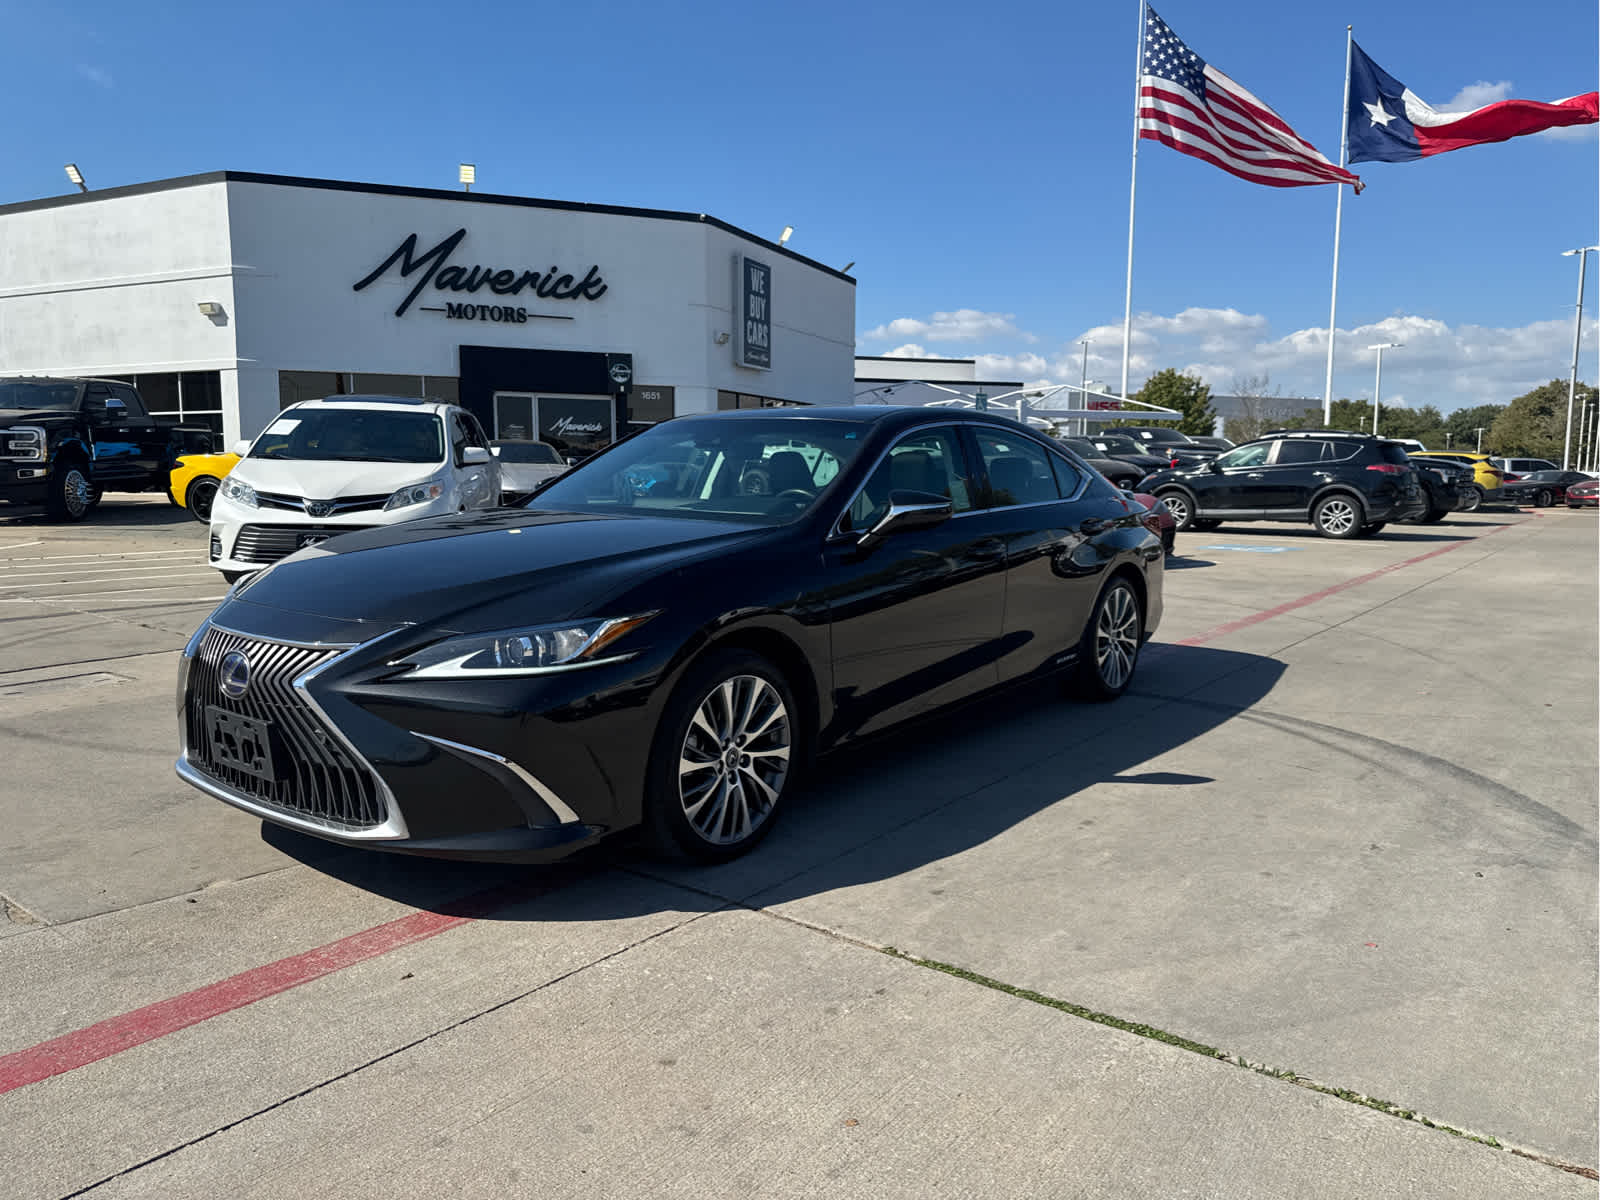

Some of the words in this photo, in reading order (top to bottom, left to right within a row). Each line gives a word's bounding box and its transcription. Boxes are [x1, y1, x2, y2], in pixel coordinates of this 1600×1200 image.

[353, 228, 608, 317] Maverick
[750, 267, 765, 294] WE
[446, 302, 528, 323] MOTORS
[749, 294, 766, 320] BUY
[746, 320, 768, 347] CARS
[641, 391, 661, 400] 1651
